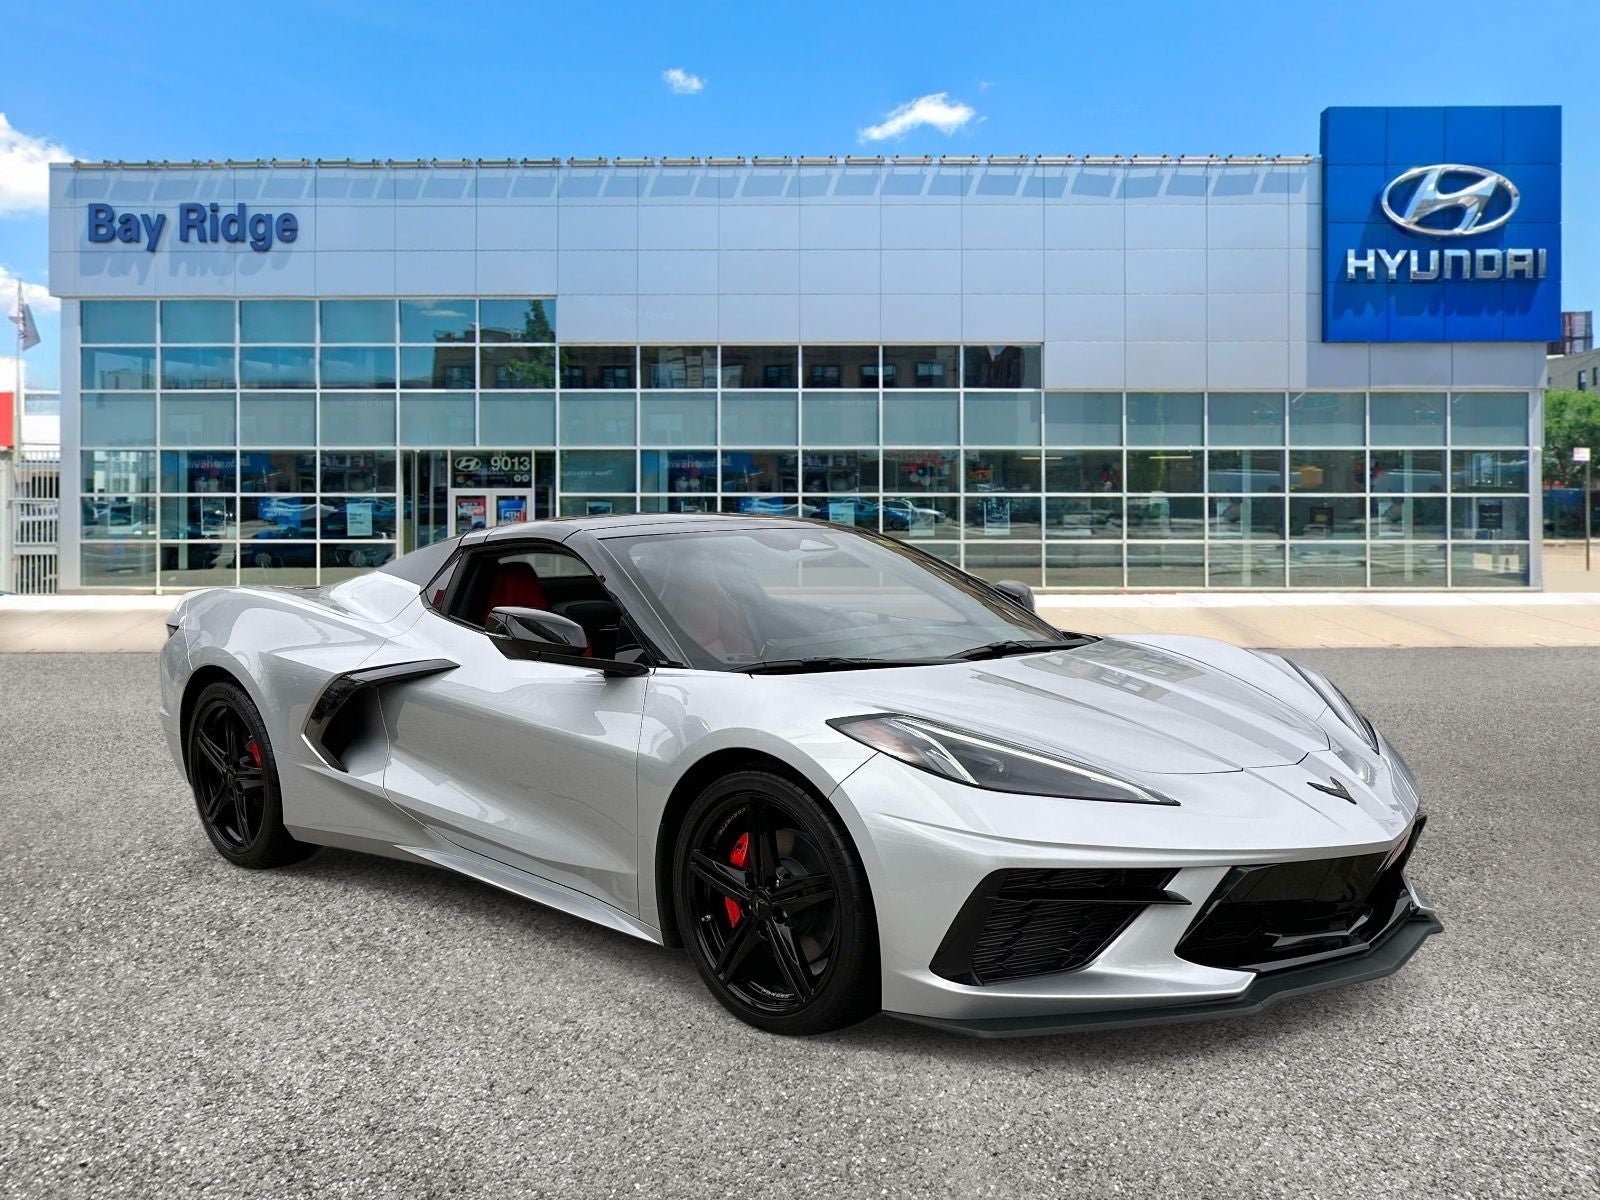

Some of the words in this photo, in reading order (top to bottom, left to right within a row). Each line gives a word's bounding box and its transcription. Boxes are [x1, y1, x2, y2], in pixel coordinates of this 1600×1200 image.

[88, 203, 166, 253] Bay
[179, 203, 299, 253] Ridge
[1346, 248, 1547, 281] HYUNDAI
[491, 457, 530, 471] 9013
